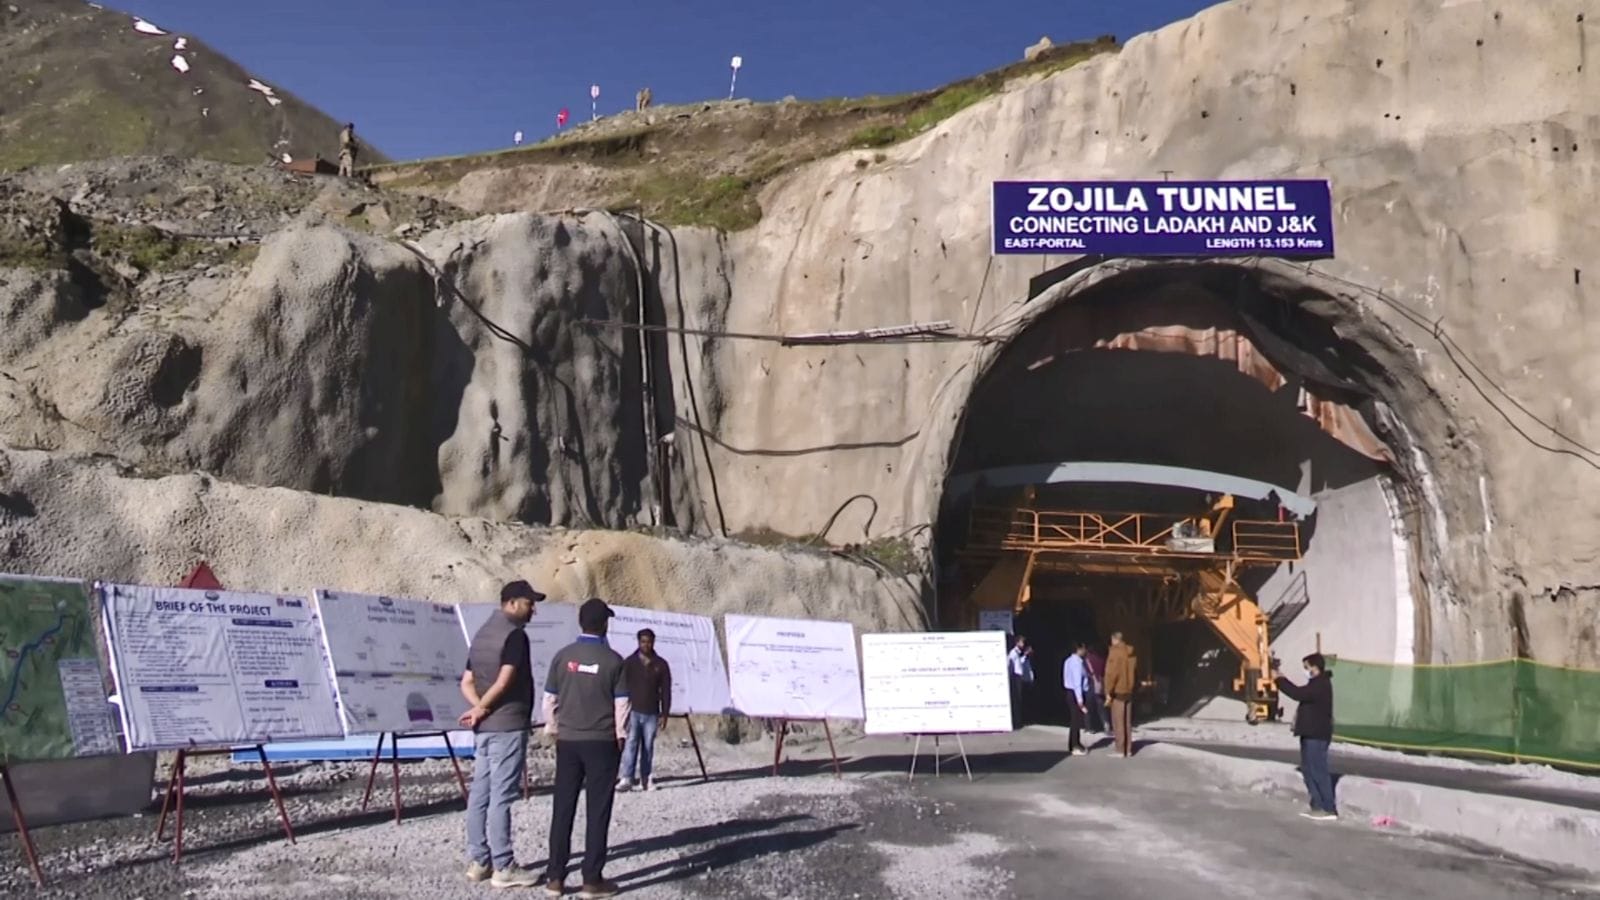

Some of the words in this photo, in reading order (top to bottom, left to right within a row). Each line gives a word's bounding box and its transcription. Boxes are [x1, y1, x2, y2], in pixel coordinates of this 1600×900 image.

[1027, 187, 1149, 212] ZOJILA
[1156, 187, 1296, 211] TUNNEL
[1009, 216, 1138, 234] CONNECTING
[1144, 216, 1225, 234] LADAKH
[1229, 216, 1272, 233] AND
[1277, 215, 1317, 233] J&K
[1004, 238, 1086, 249] EAST-PORTAL
[1206, 238, 1256, 249] LENGTH
[1258, 238, 1295, 249] 13.153
[1297, 238, 1324, 248] Kms
[155, 600, 186, 612] BRIEF
[189, 602, 204, 613] OF
[206, 603, 228, 614] THE
[229, 604, 271, 616] PROJECT
